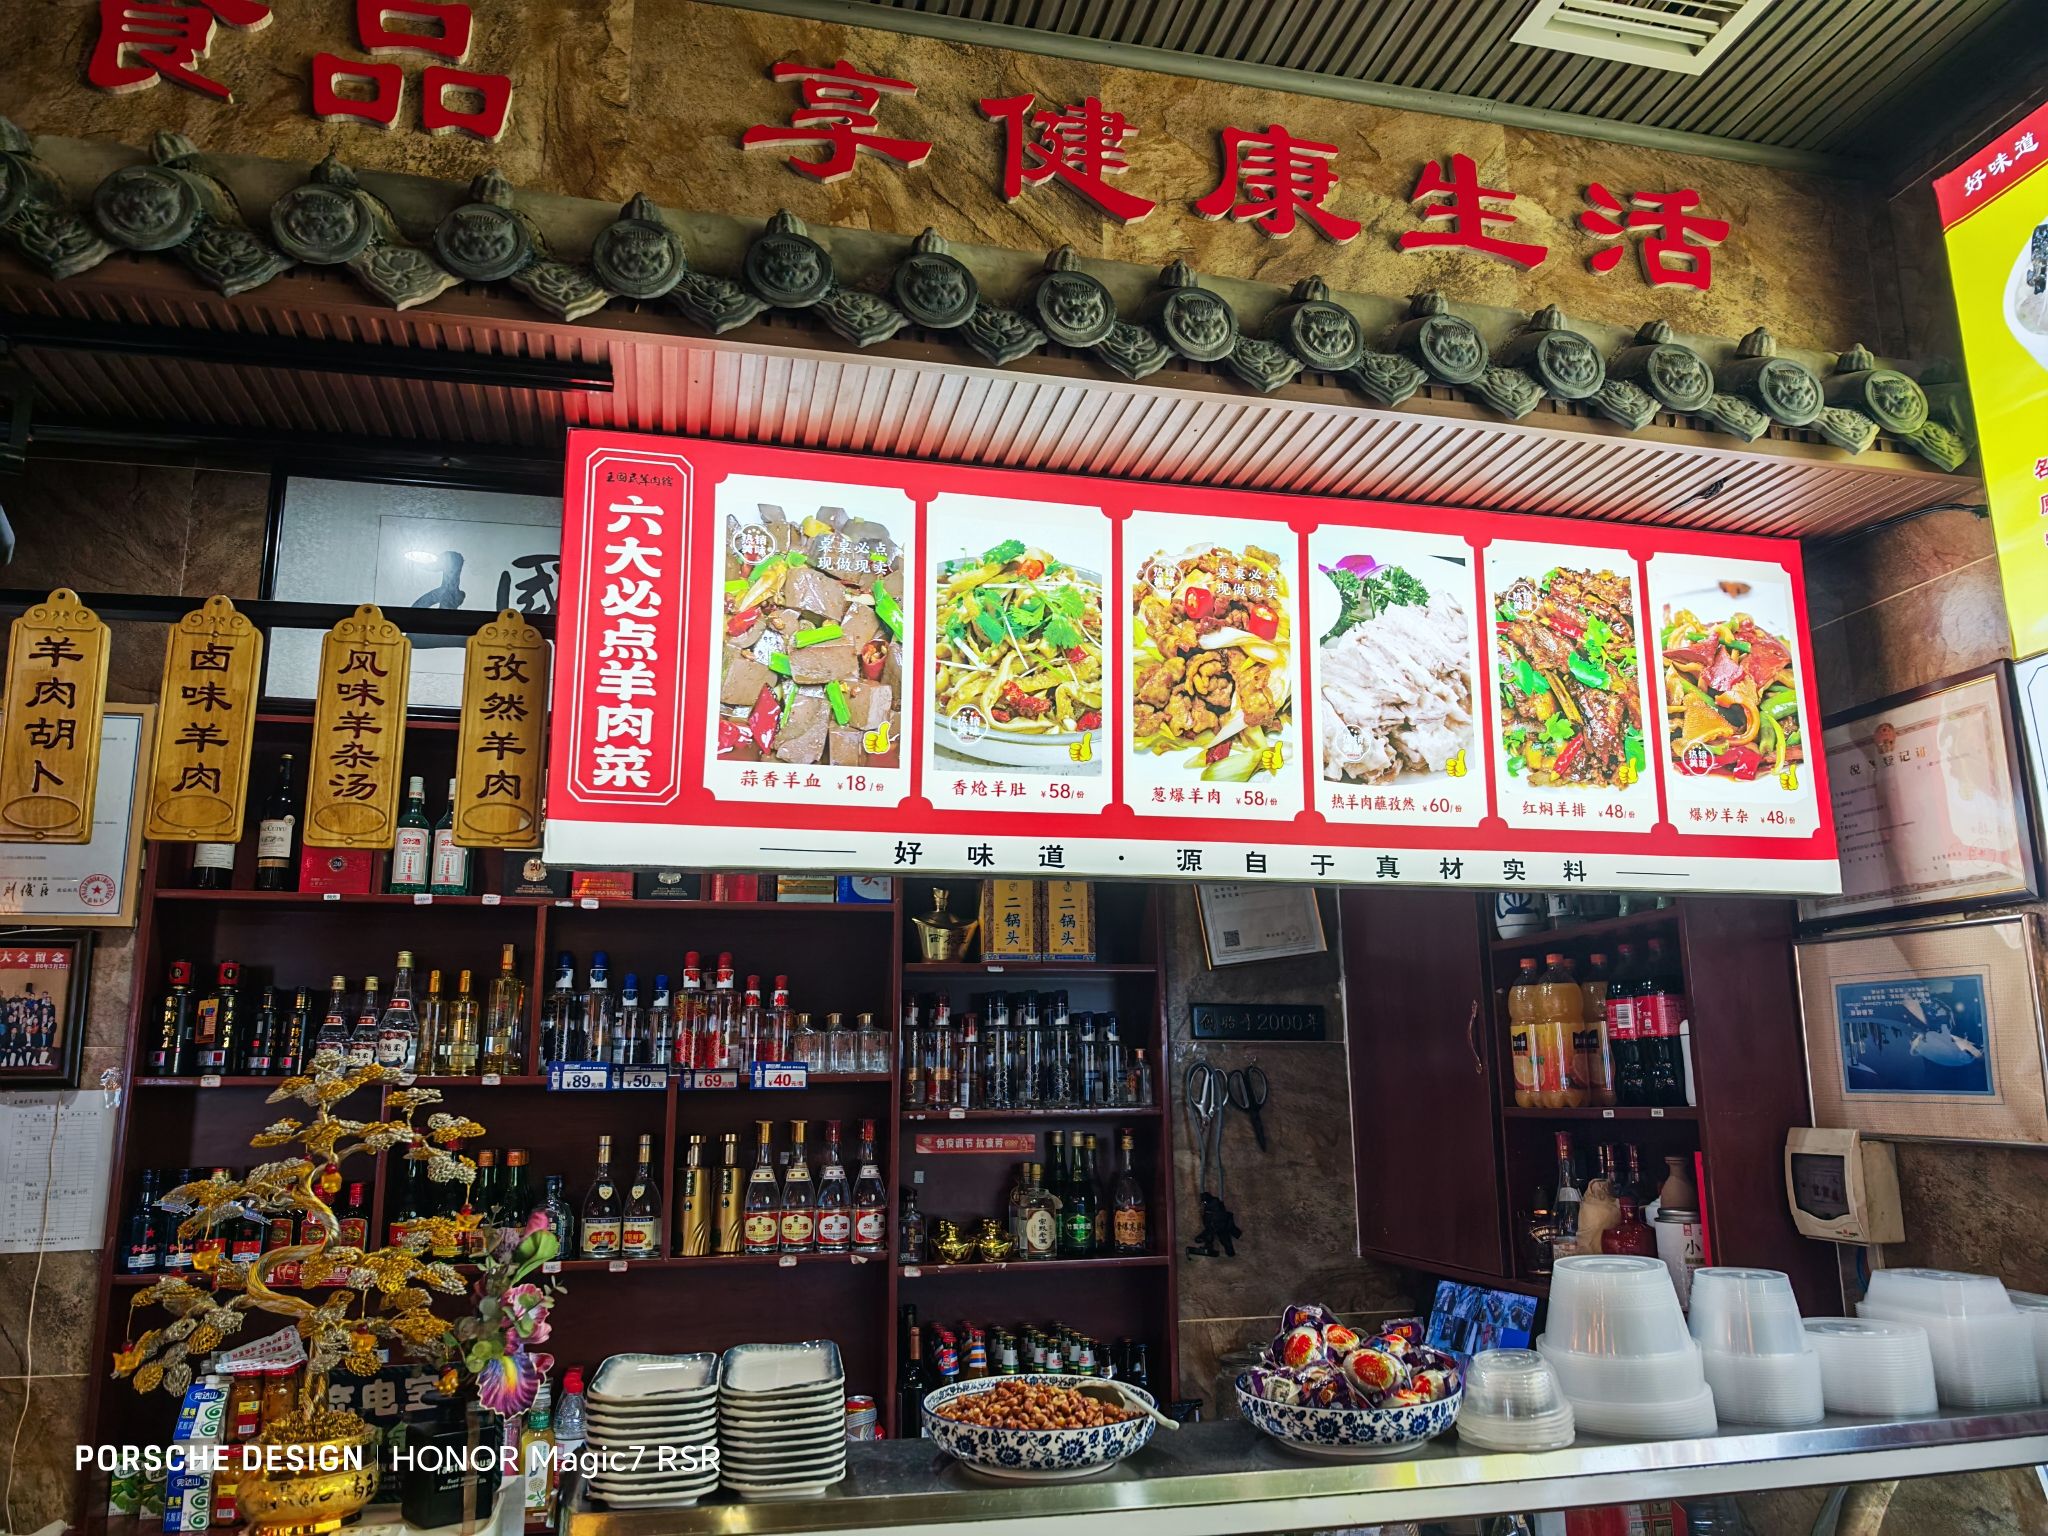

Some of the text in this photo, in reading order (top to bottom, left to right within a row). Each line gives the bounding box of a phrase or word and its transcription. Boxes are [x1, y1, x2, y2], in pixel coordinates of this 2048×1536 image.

[1964, 131, 2040, 197] 好味道
[742, 58, 1731, 292] 享健康生活
[818, 536, 888, 557] 桌桌必点
[1216, 565, 1279, 581] 桌桌必点
[1216, 583, 1279, 599] 现做现卖
[592, 495, 665, 789] 六大必点羊肉菜
[24, 635, 85, 793] 羊肉胡卜
[171, 641, 234, 795] 卤味羊肉
[328, 648, 389, 801] 风味羊杂汤
[475, 652, 531, 801] 孜然羊肉
[740, 770, 822, 788] 蒜香羊血
[951, 779, 1027, 797] 香炝羊肚
[1151, 787, 1221, 804] 葱爆羊肉
[1331, 794, 1415, 812] 热羊肉蘸孜然
[1522, 801, 1587, 818] 红焖羊排
[1688, 807, 1750, 824] 爆炒羊杂
[530, 863, 541, 871] 20
[1004, 897, 1021, 945] 二锅头
[1059, 898, 1076, 946] 二锅头
[0, 950, 65, 963] 大会留念
[936, 1137, 973, 1149] 免疫调节
[194, 1391, 218, 1400] 完达山
[176, 1477, 200, 1487] 完达山
